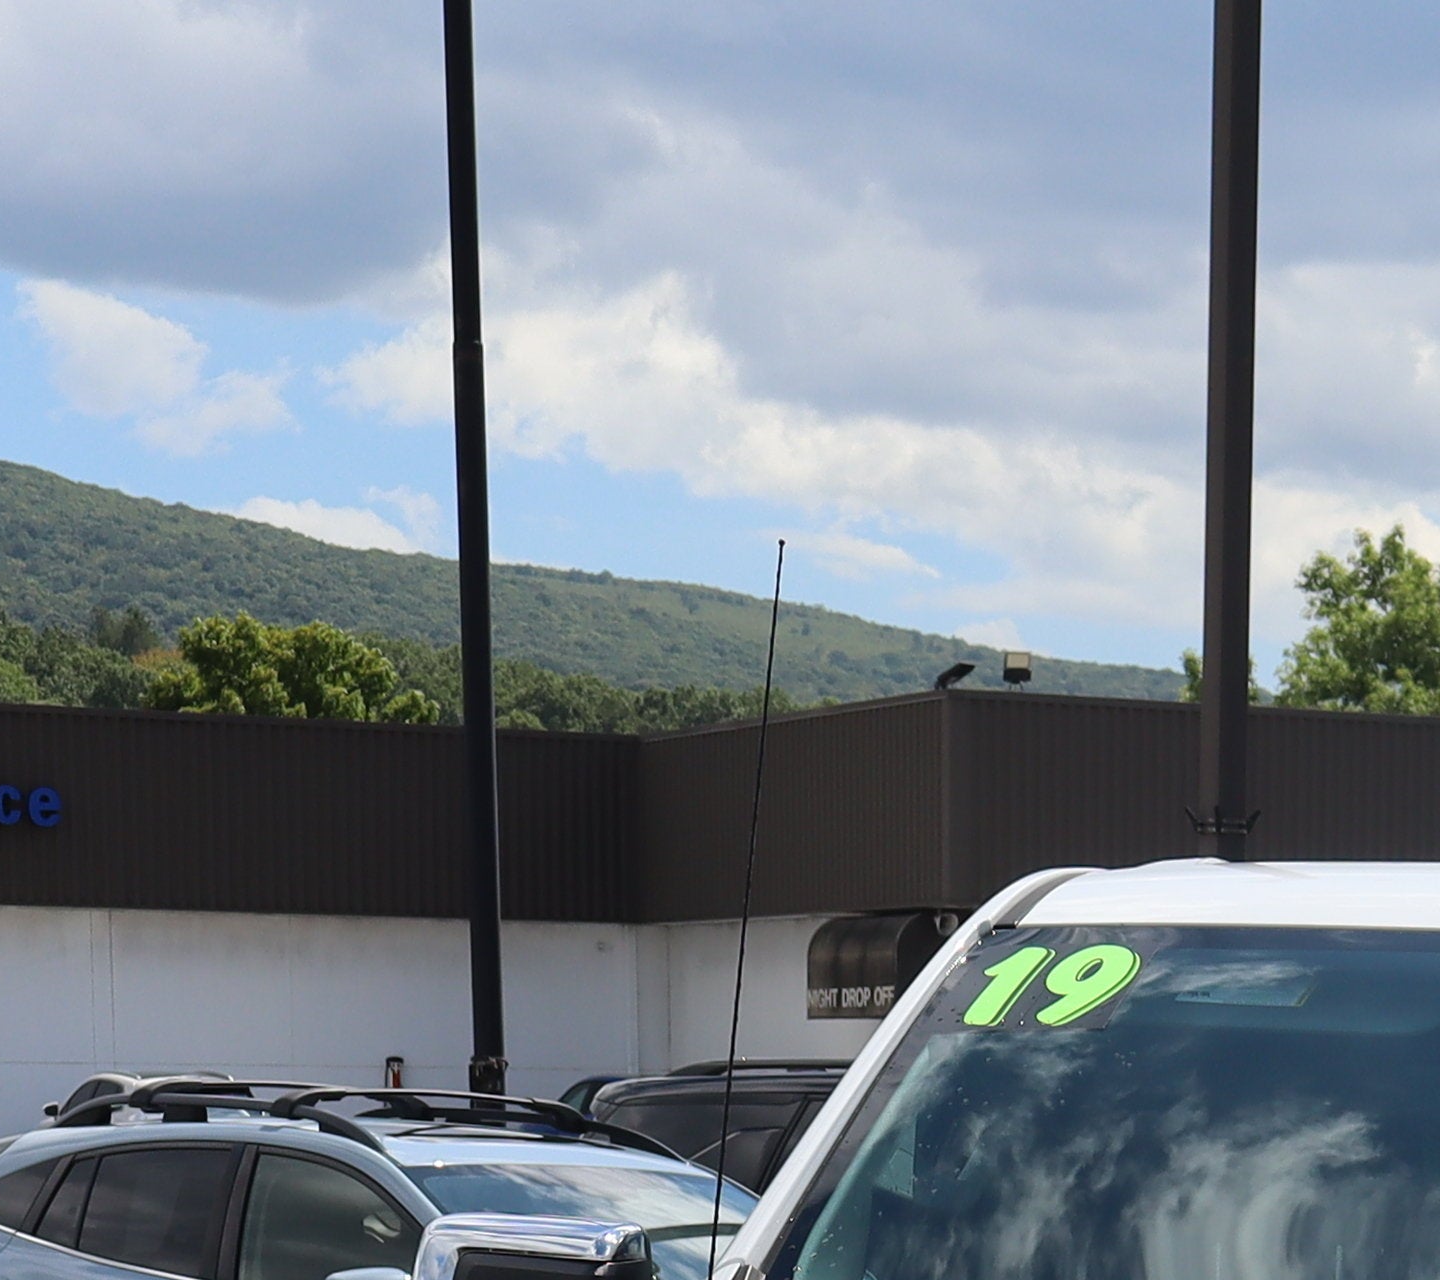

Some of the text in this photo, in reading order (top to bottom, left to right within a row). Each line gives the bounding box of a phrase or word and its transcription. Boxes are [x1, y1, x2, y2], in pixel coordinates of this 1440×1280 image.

[807, 985, 896, 1008] NIGHT DROP OFF
[963, 944, 1142, 1027] 19
